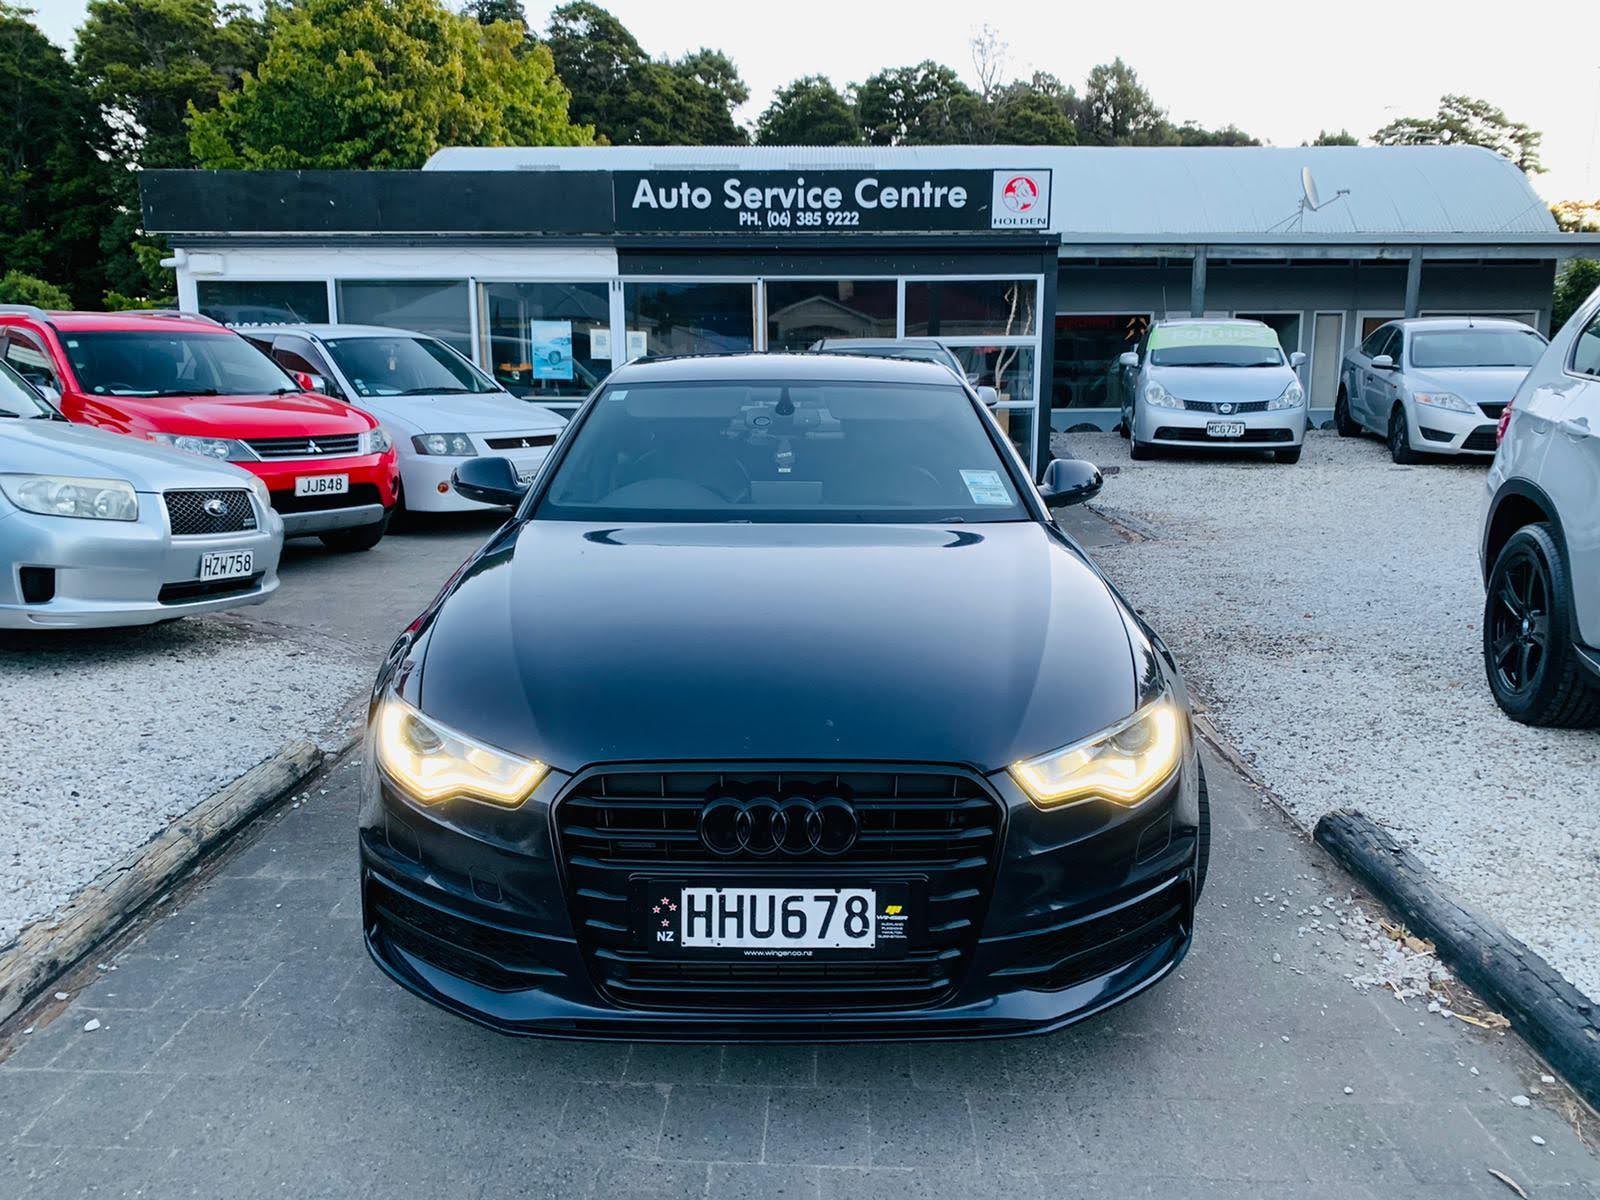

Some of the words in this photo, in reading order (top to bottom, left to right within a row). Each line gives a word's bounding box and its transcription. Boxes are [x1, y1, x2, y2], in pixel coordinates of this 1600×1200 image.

[632, 178, 712, 209] Auto
[723, 177, 843, 209] Service
[854, 178, 968, 209] Centre
[739, 211, 762, 226] PH.
[767, 210, 791, 227] (06)
[796, 211, 822, 226] 385
[826, 211, 859, 226] 9222
[993, 217, 1047, 226] HOLDEN
[302, 477, 343, 494] JJB48
[204, 553, 251, 577] HZW758
[686, 894, 871, 940] HHU678
[656, 931, 674, 942] NZ
